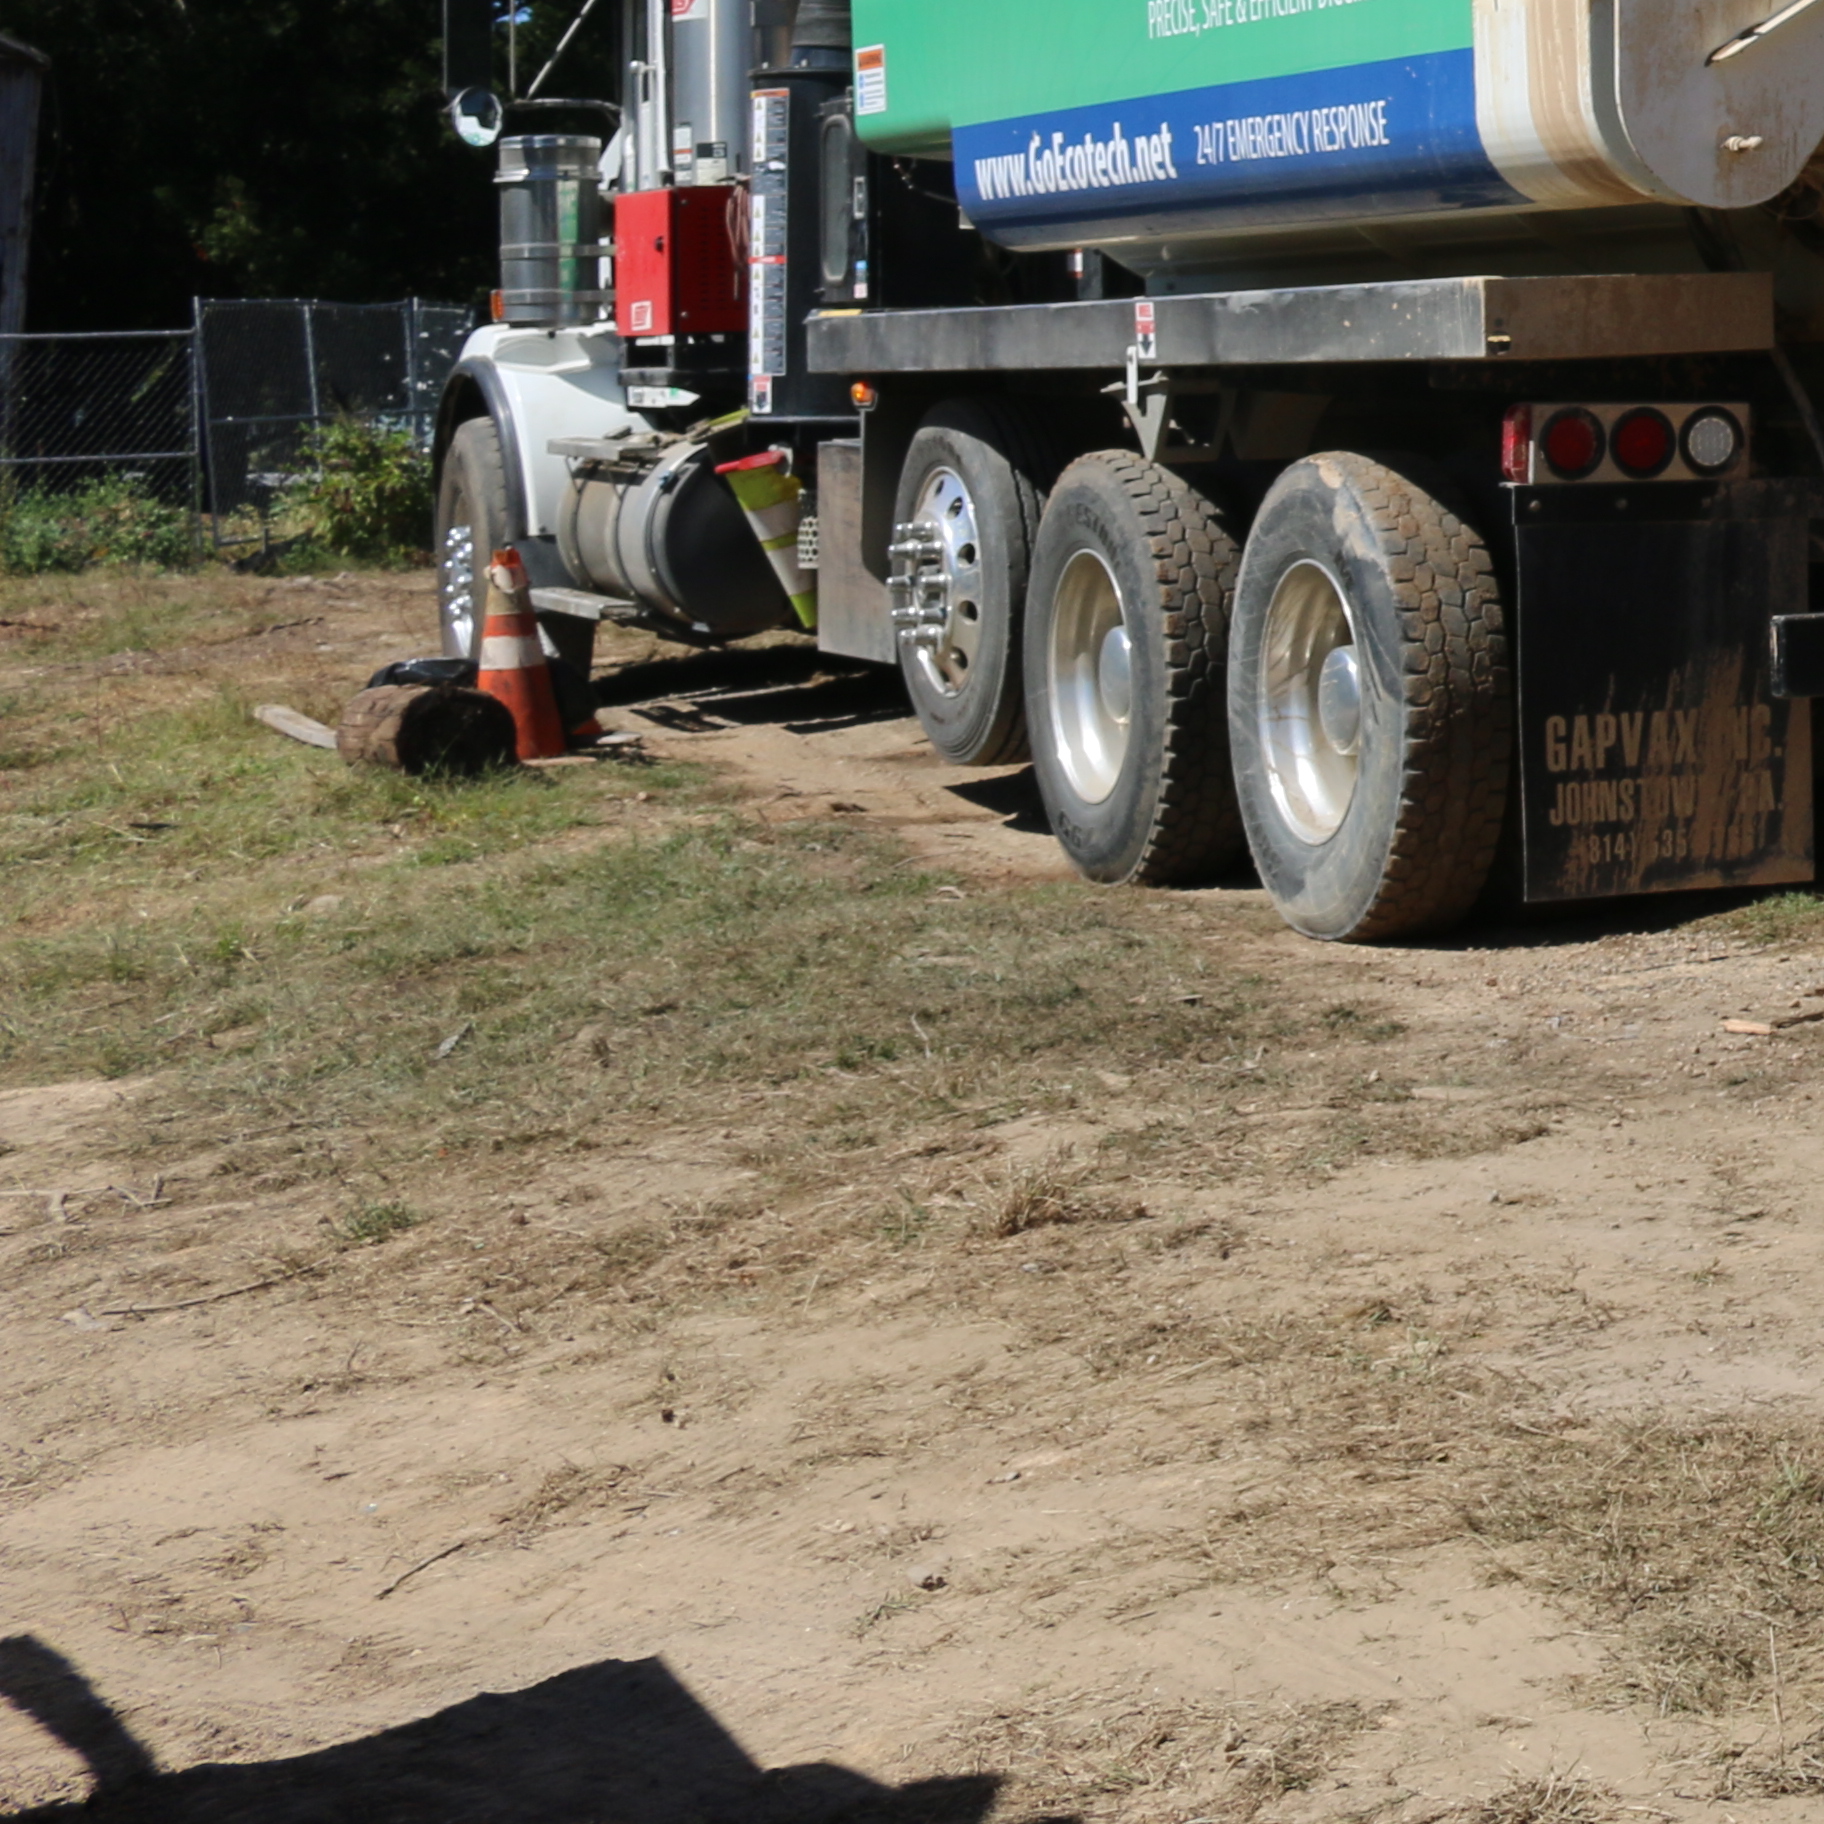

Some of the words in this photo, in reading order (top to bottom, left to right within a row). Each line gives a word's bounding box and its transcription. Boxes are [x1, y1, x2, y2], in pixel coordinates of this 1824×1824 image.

[974, 121, 1178, 202] www.GoEcotech.net
[1193, 122, 1225, 165] 24/7
[1227, 112, 1312, 162] EMERGENCY
[1312, 99, 1391, 153] RESPONSE
[1545, 707, 1698, 773] GAPVAX
